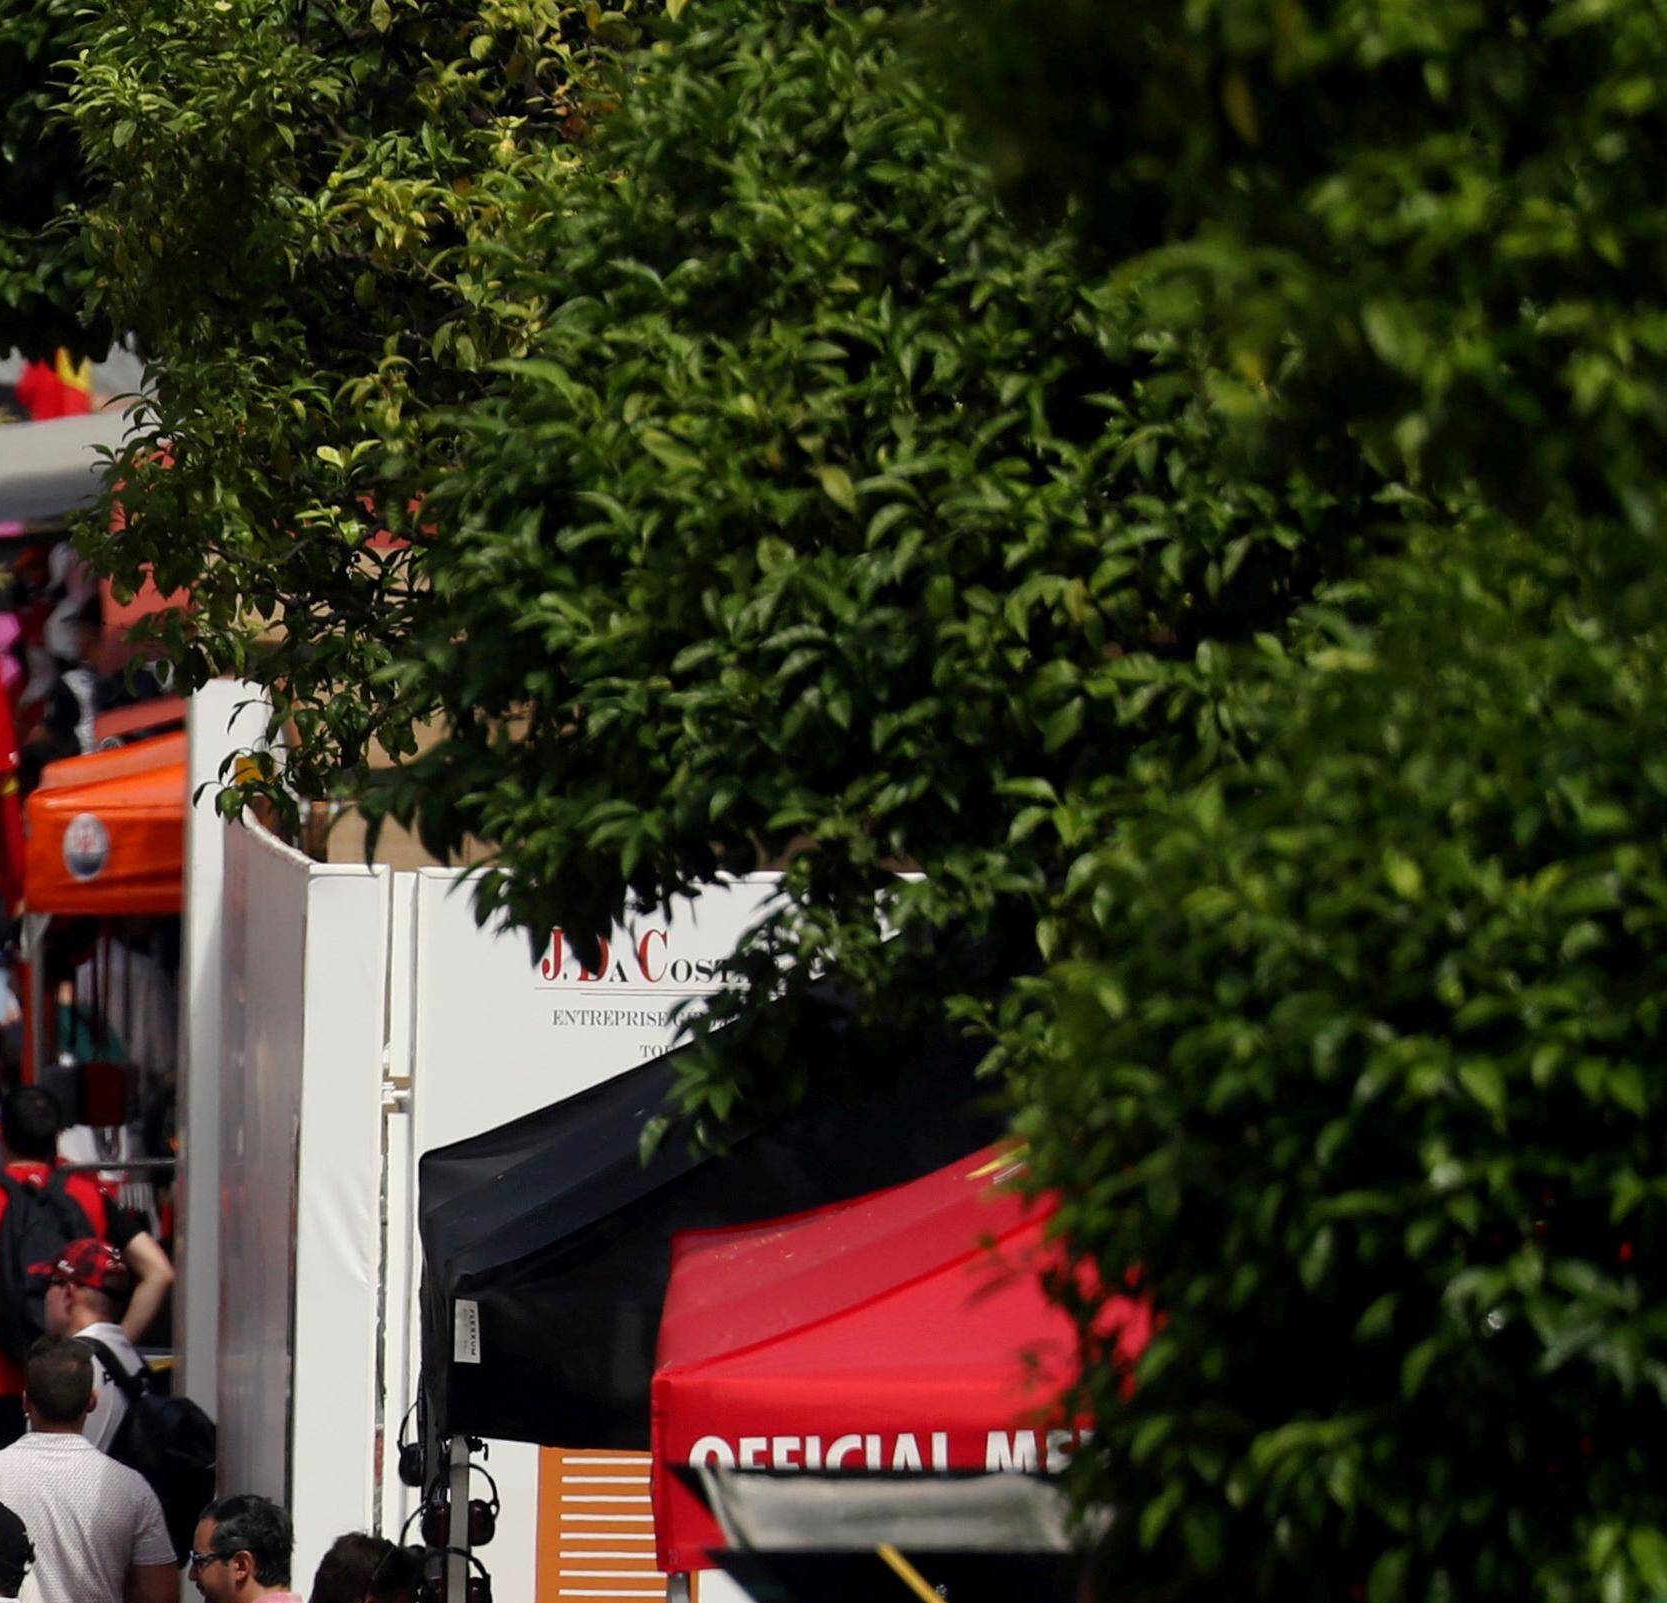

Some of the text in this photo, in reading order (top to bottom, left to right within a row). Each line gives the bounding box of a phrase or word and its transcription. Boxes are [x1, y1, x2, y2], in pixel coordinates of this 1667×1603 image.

[638, 929, 744, 984] COST
[552, 1009, 667, 1027] ENTREPRISE
[985, 1429, 1097, 1474] ME
